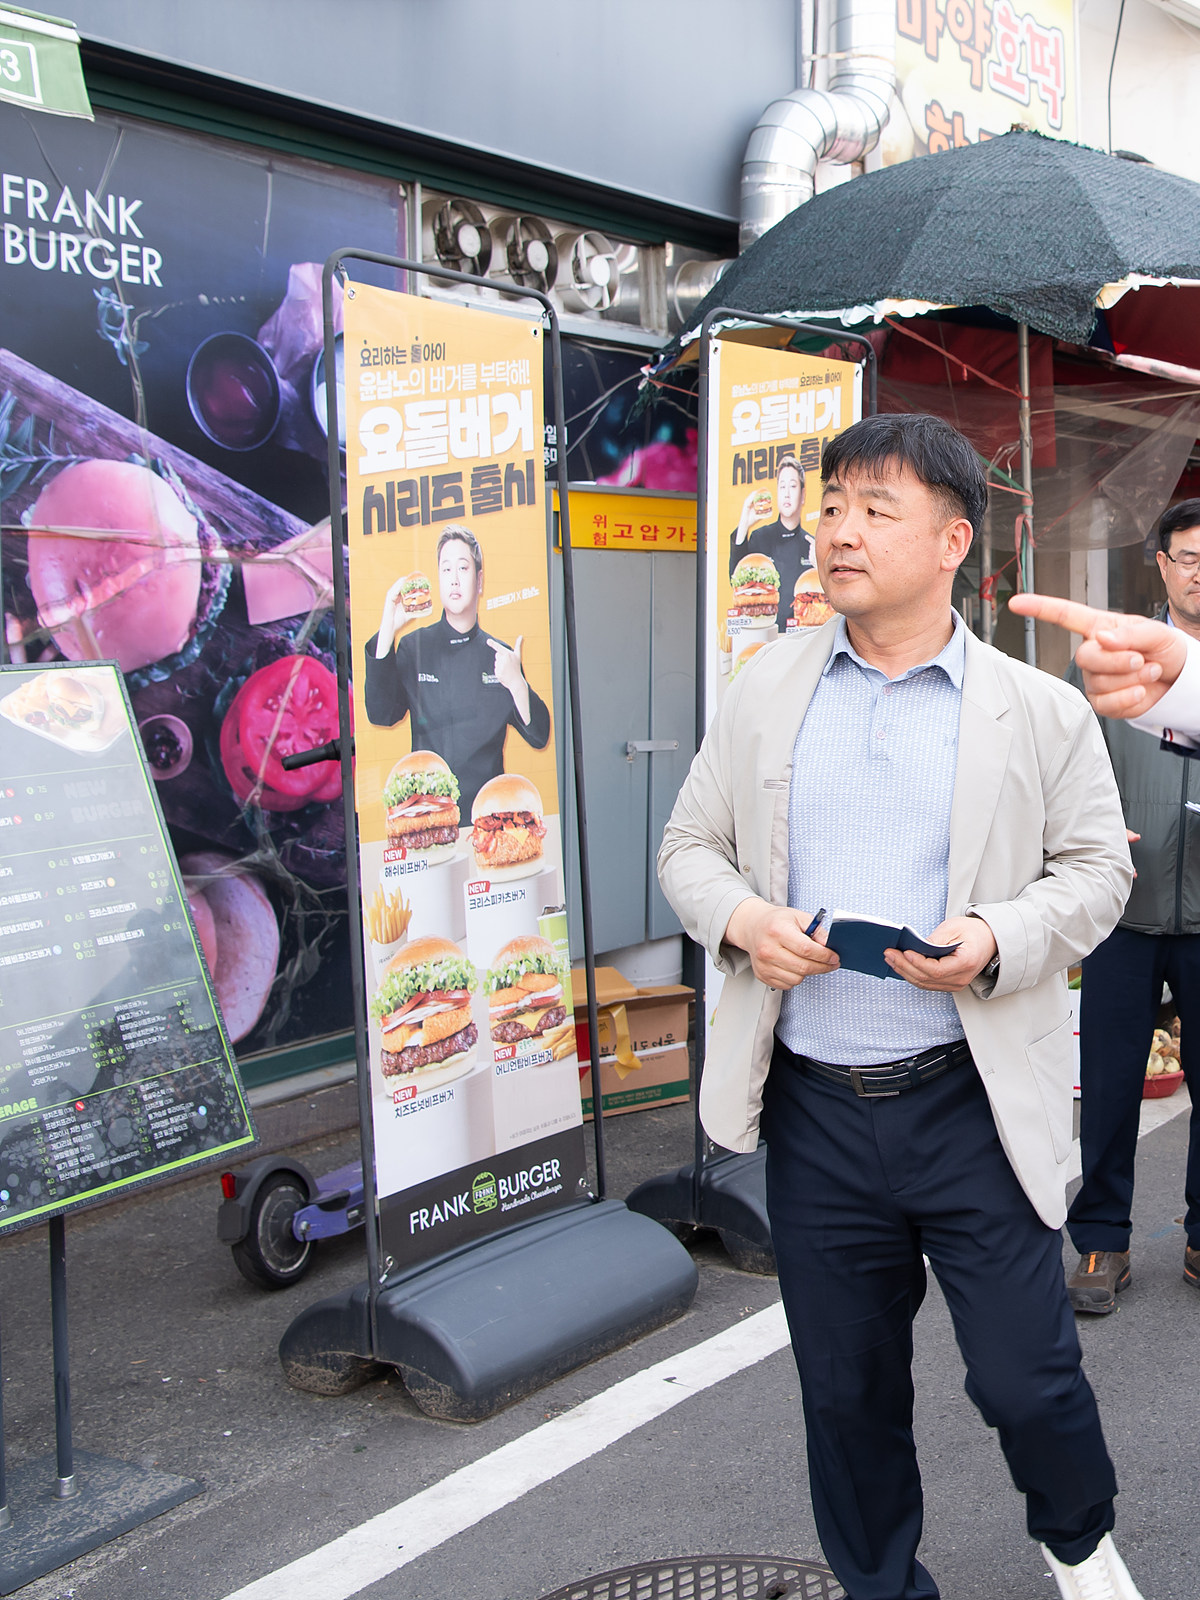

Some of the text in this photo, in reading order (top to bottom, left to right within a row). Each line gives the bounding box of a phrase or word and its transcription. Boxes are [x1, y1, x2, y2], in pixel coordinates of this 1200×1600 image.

[2, 173, 144, 239] FRANK
[3, 222, 163, 288] BURGER
[360, 345, 407, 368] 요리하는
[359, 359, 530, 402] 윤남노의 버거를 부탁해!
[731, 386, 842, 447] 요돌버거
[358, 389, 534, 475] 요돌버거
[362, 458, 536, 536] 시리즈 출시
[70, 799, 146, 824] BURGER
[383, 850, 404, 862] NEW
[384, 860, 429, 878] 해쉬비프버거
[468, 882, 489, 894] NEW
[469, 889, 527, 911] 크리스피카츠버거
[494, 1047, 514, 1060] NEW
[393, 1089, 413, 1103] NEW
[409, 1192, 471, 1235] FRANK
[497, 1158, 562, 1200] BURGER
